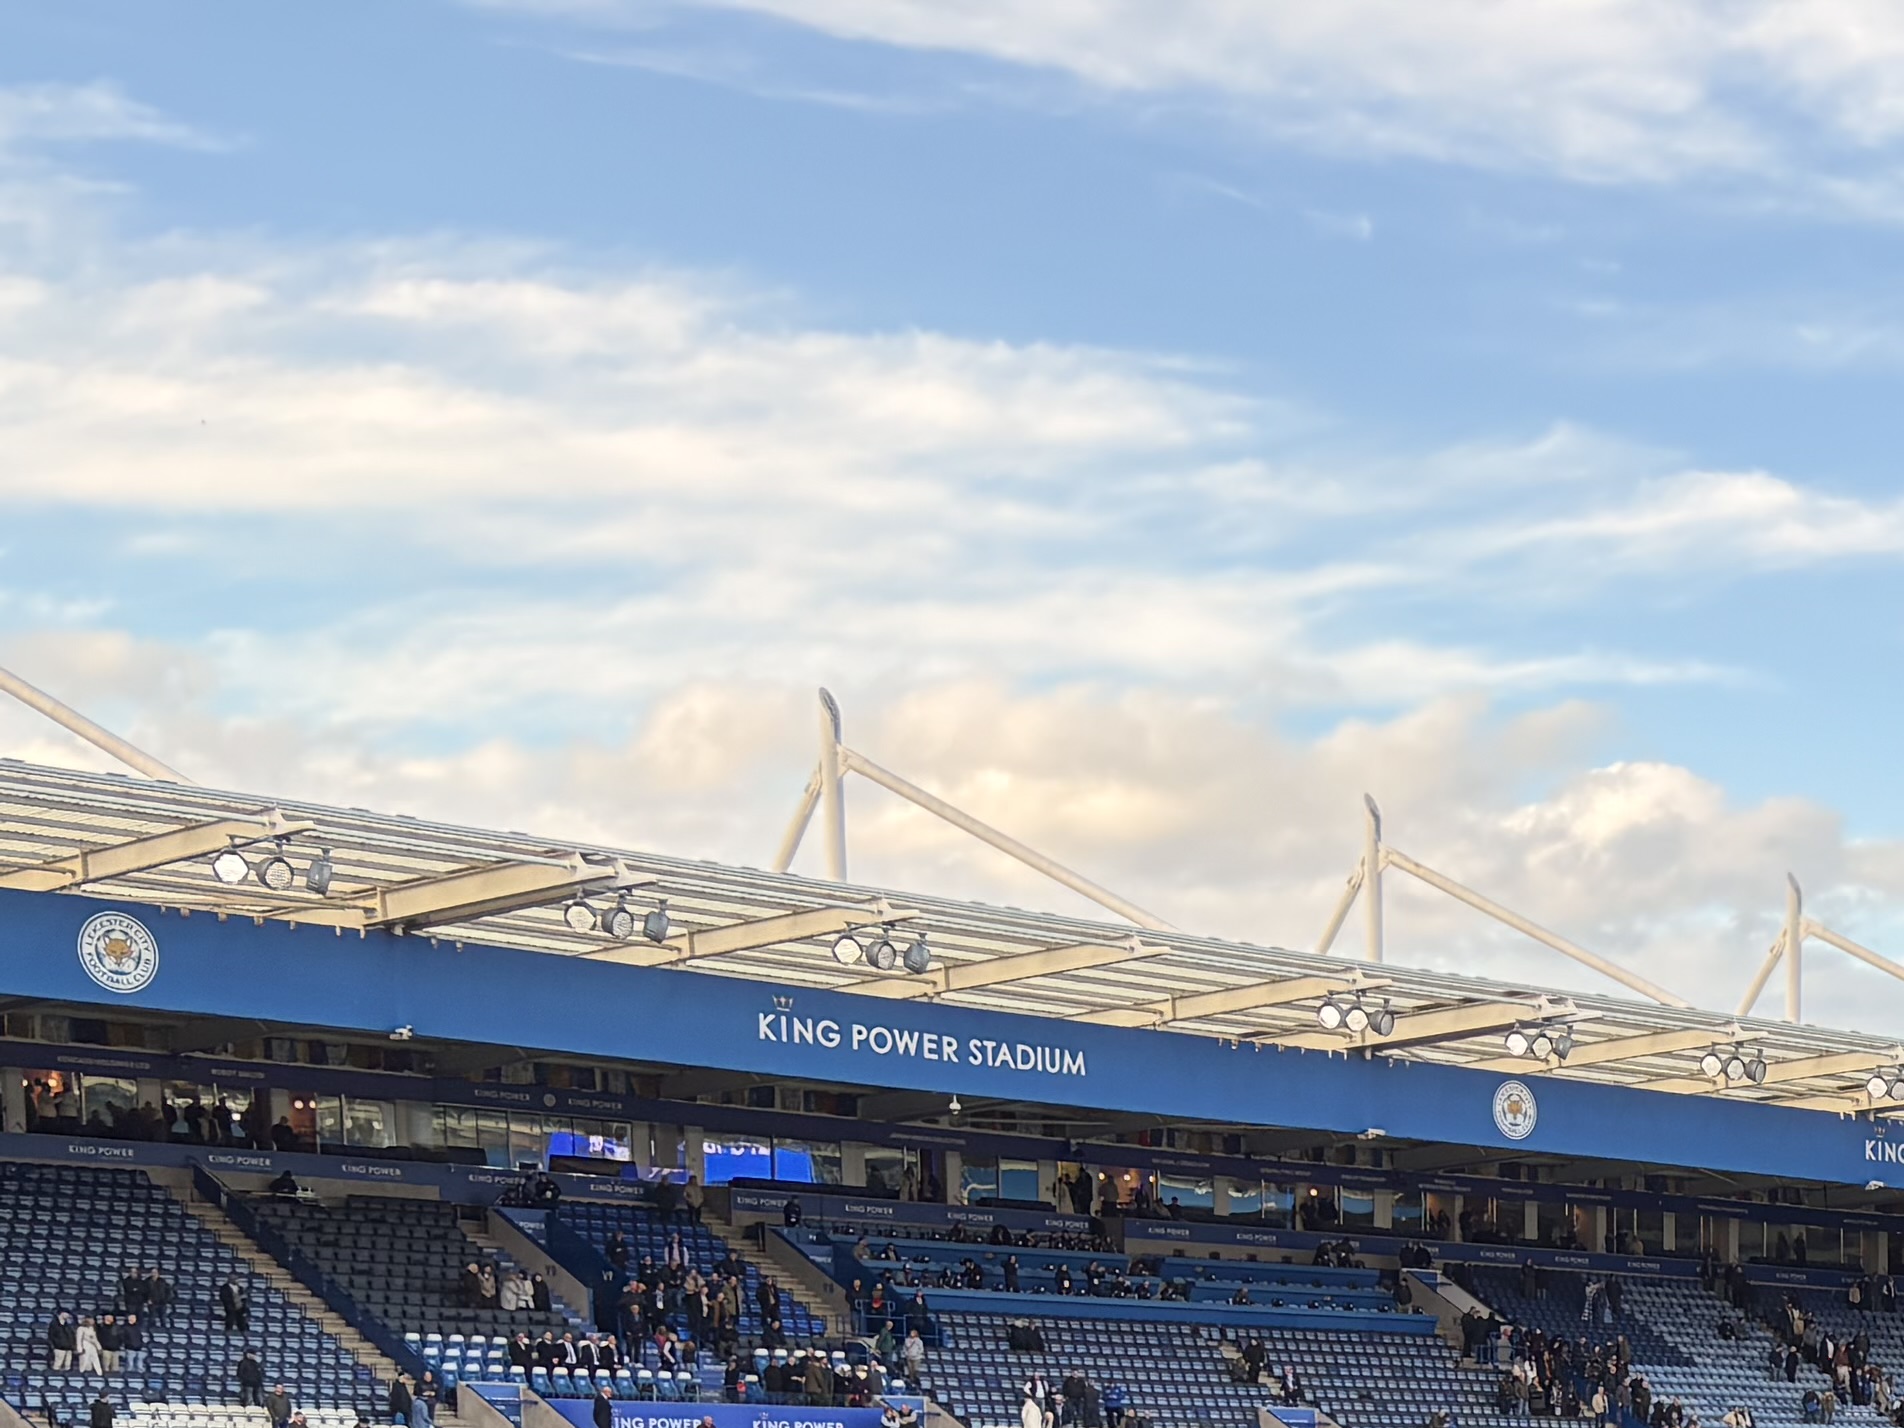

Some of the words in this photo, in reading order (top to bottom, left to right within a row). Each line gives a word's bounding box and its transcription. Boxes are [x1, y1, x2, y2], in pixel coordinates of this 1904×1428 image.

[758, 1012, 841, 1048] KING
[852, 1023, 959, 1063] POWER
[968, 1038, 1086, 1077] STADIUM
